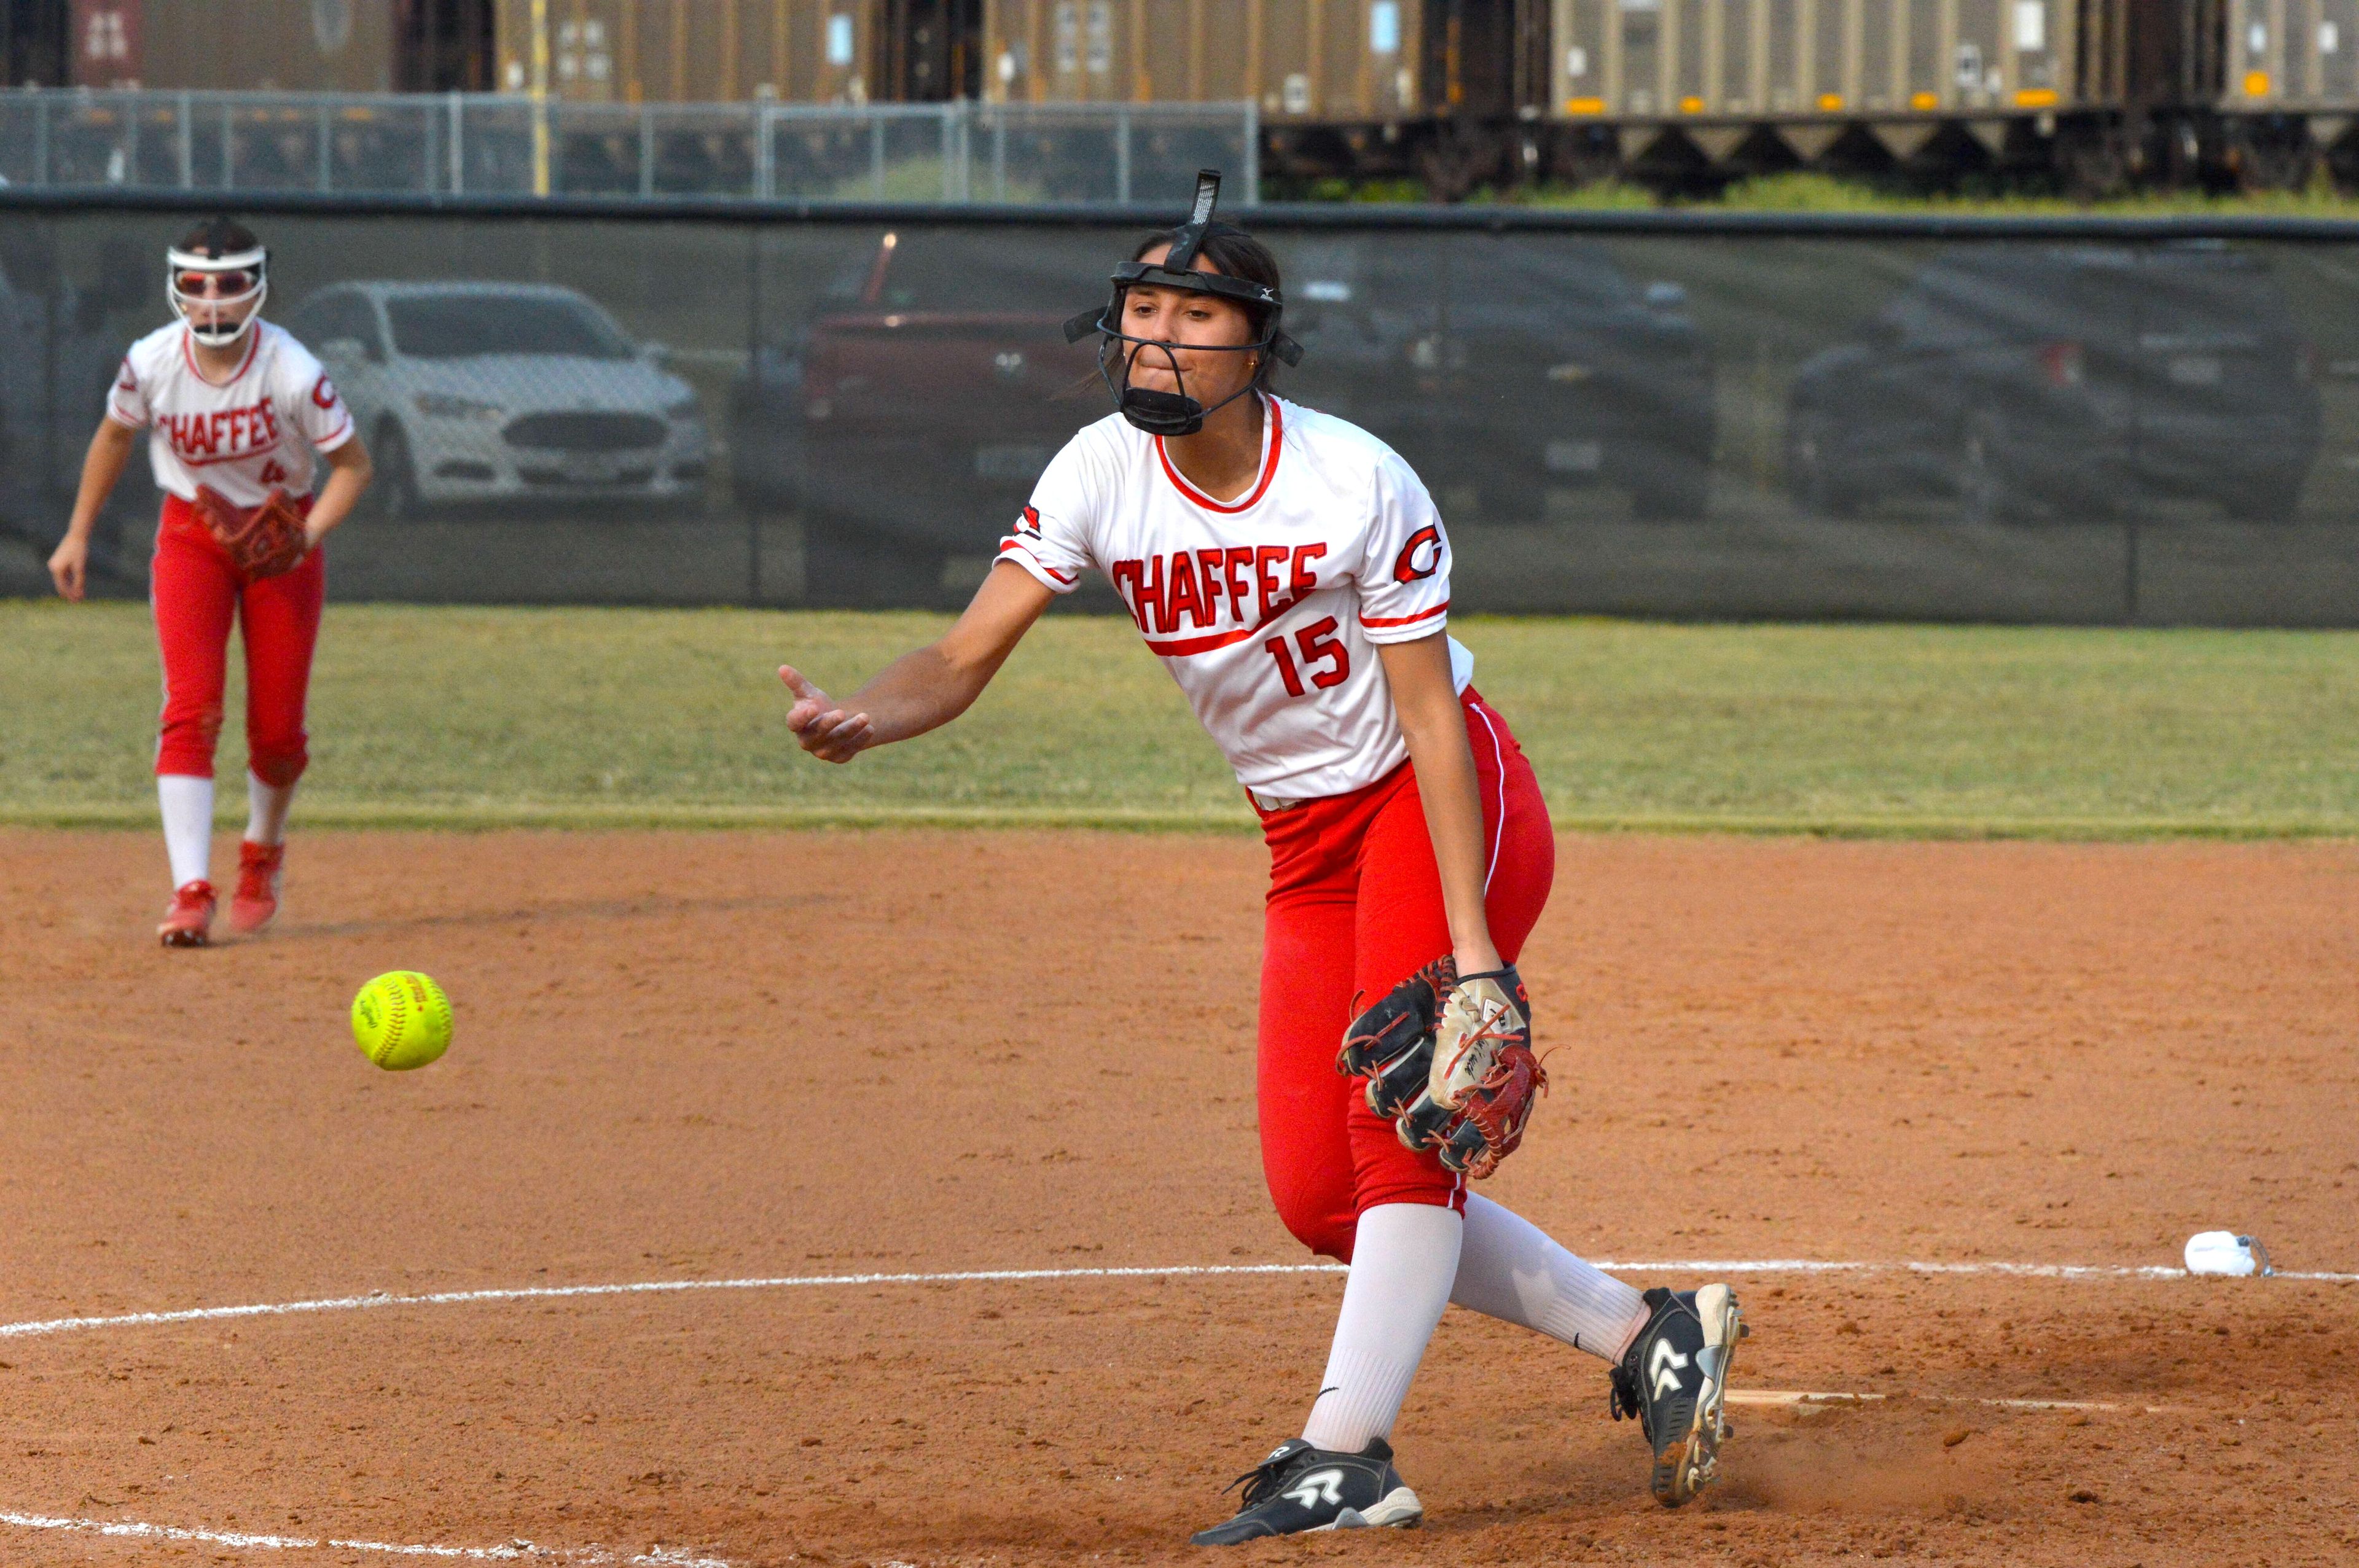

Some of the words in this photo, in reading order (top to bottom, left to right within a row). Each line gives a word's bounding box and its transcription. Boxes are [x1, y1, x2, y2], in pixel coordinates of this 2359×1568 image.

[160, 397, 278, 454] HAFFEE
[1393, 522, 1442, 585] C
[1265, 615, 1350, 697] 15
